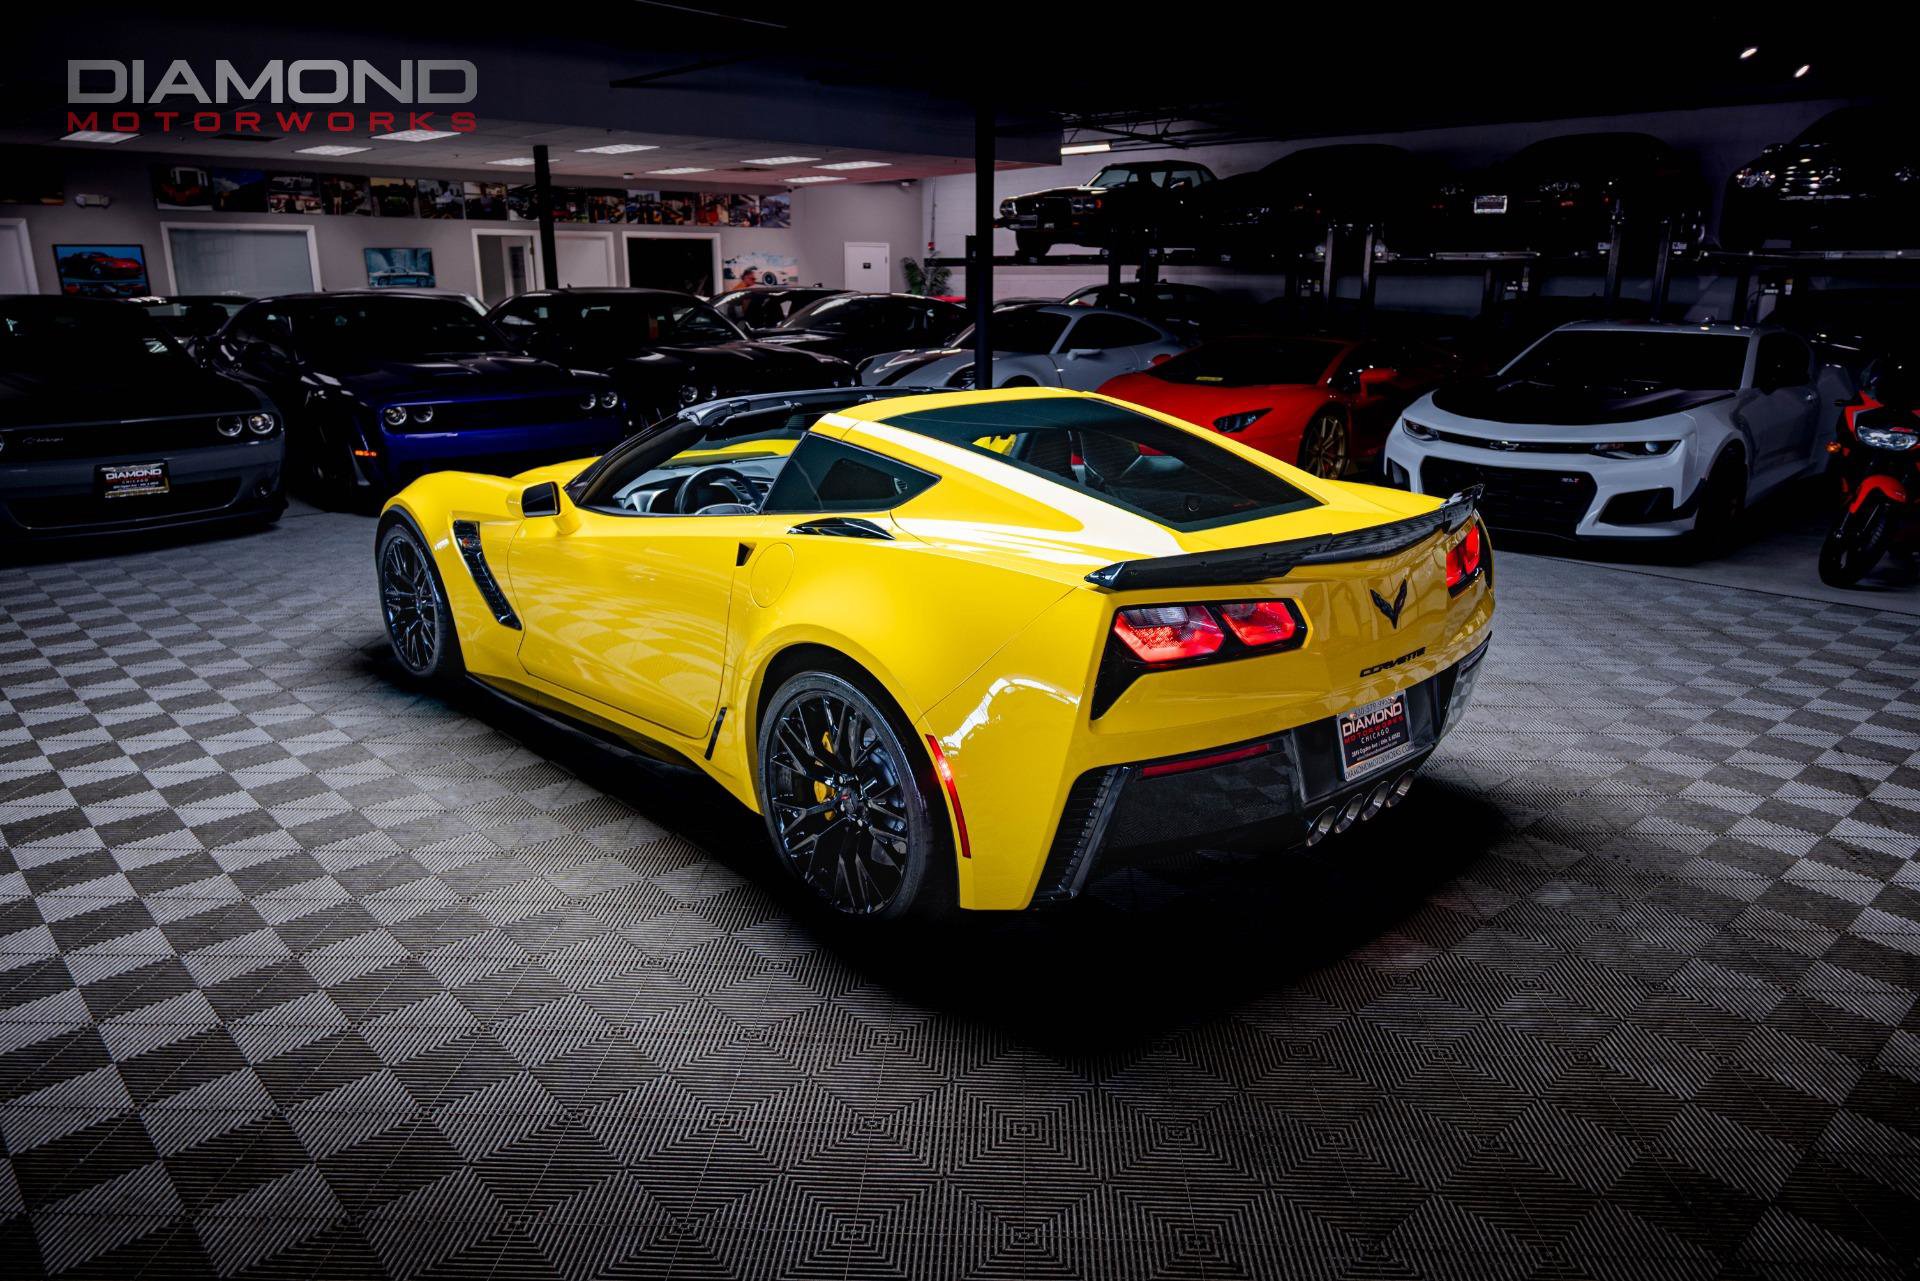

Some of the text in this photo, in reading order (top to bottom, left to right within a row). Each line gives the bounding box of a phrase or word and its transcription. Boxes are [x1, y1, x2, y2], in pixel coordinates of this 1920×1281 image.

[105, 468, 162, 480] DIAMOND
[1342, 702, 1403, 737] DIAMOND
[1360, 727, 1390, 744] CHICAGO
